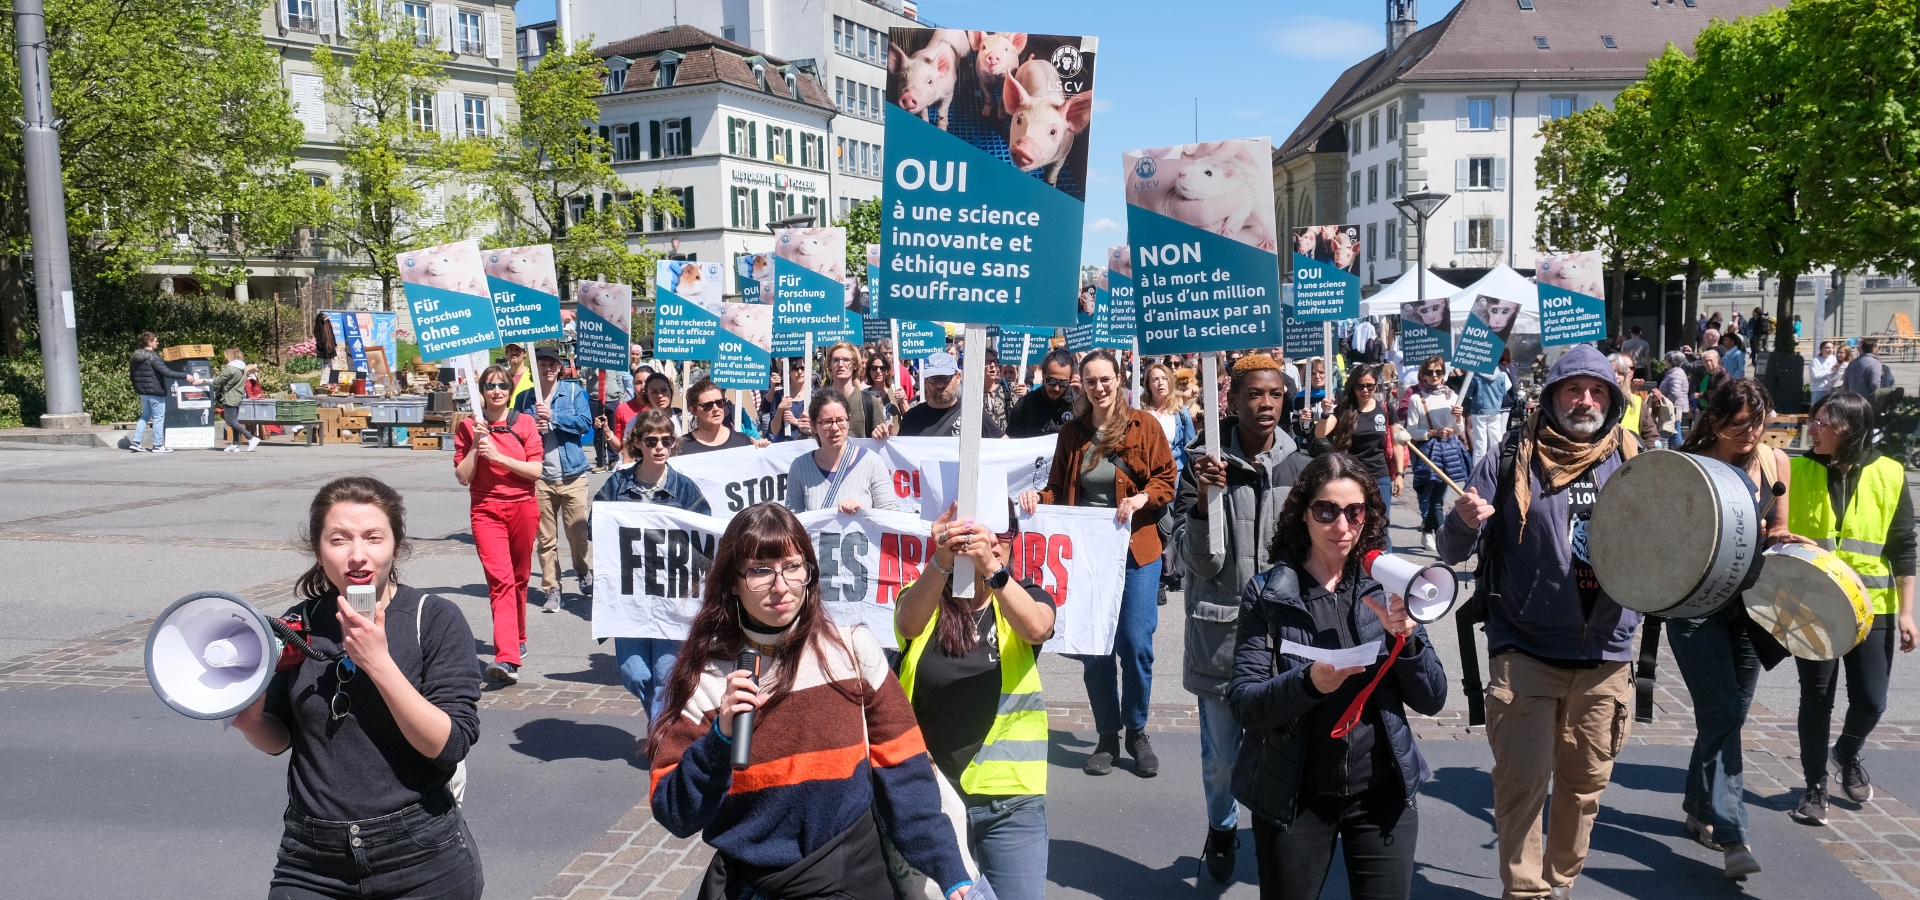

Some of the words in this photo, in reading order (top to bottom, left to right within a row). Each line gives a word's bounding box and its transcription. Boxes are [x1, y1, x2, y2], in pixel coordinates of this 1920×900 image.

[1048, 81, 1083, 93] LSCV
[895, 158, 968, 193] OUI
[1134, 180, 1159, 190] LSCV
[893, 199, 905, 220] à
[912, 206, 951, 222] une
[958, 204, 1040, 227] science
[892, 226, 1003, 251] innovante
[1009, 233, 1033, 253] et
[1139, 242, 1202, 267] NON
[891, 253, 976, 282] éthique
[981, 262, 1030, 279] sans
[1298, 268, 1322, 279] OUI
[779, 274, 802, 287] Für
[1141, 274, 1150, 288] à
[1153, 272, 1167, 286] la
[1170, 271, 1208, 285] mort
[1211, 268, 1231, 282] de
[744, 286, 759, 296] OUI
[778, 289, 826, 299] Forschung
[890, 281, 1009, 303] souffrance
[1014, 286, 1021, 304] !
[1142, 291, 1173, 308] plus
[1213, 285, 1266, 301] million
[1297, 290, 1335, 298] innovante
[494, 291, 517, 304] Für
[1297, 298, 1327, 307] éthique
[1543, 296, 1572, 309] NON
[414, 299, 440, 315] Für
[495, 304, 542, 314] Forschung
[660, 304, 683, 316] OUI
[778, 300, 812, 313] ohne
[1223, 305, 1248, 321] par
[1252, 303, 1271, 316] an
[1297, 307, 1338, 315] souffrance
[1557, 308, 1574, 316] mort
[416, 308, 472, 326] Forschung
[497, 315, 531, 327] ohne
[659, 318, 664, 326] à
[681, 319, 717, 327] recherche
[778, 314, 840, 324] Tierversuche!
[1544, 318, 1559, 327] plus
[1576, 313, 1600, 322] million
[499, 324, 559, 338] Tierversuche!
[580, 321, 603, 332] NON
[658, 327, 675, 335] sûre
[686, 328, 715, 336] efficace
[902, 322, 917, 331] Für
[1145, 328, 1179, 343] pour
[1183, 324, 1197, 338] la
[1200, 321, 1257, 337] science
[1466, 326, 1489, 339] NON
[421, 325, 460, 342] ohne
[1404, 328, 1428, 338] NON
[1545, 334, 1561, 342] pour
[1571, 329, 1596, 338] science
[423, 331, 495, 353] Tierversuche!
[605, 342, 625, 350] million
[686, 337, 706, 345] santé
[902, 338, 925, 347] ohne
[1473, 340, 1494, 348] cruelles
[658, 345, 690, 353] humaine
[599, 357, 620, 366] science
[724, 473, 788, 513] STOP
[819, 531, 869, 603] ES
